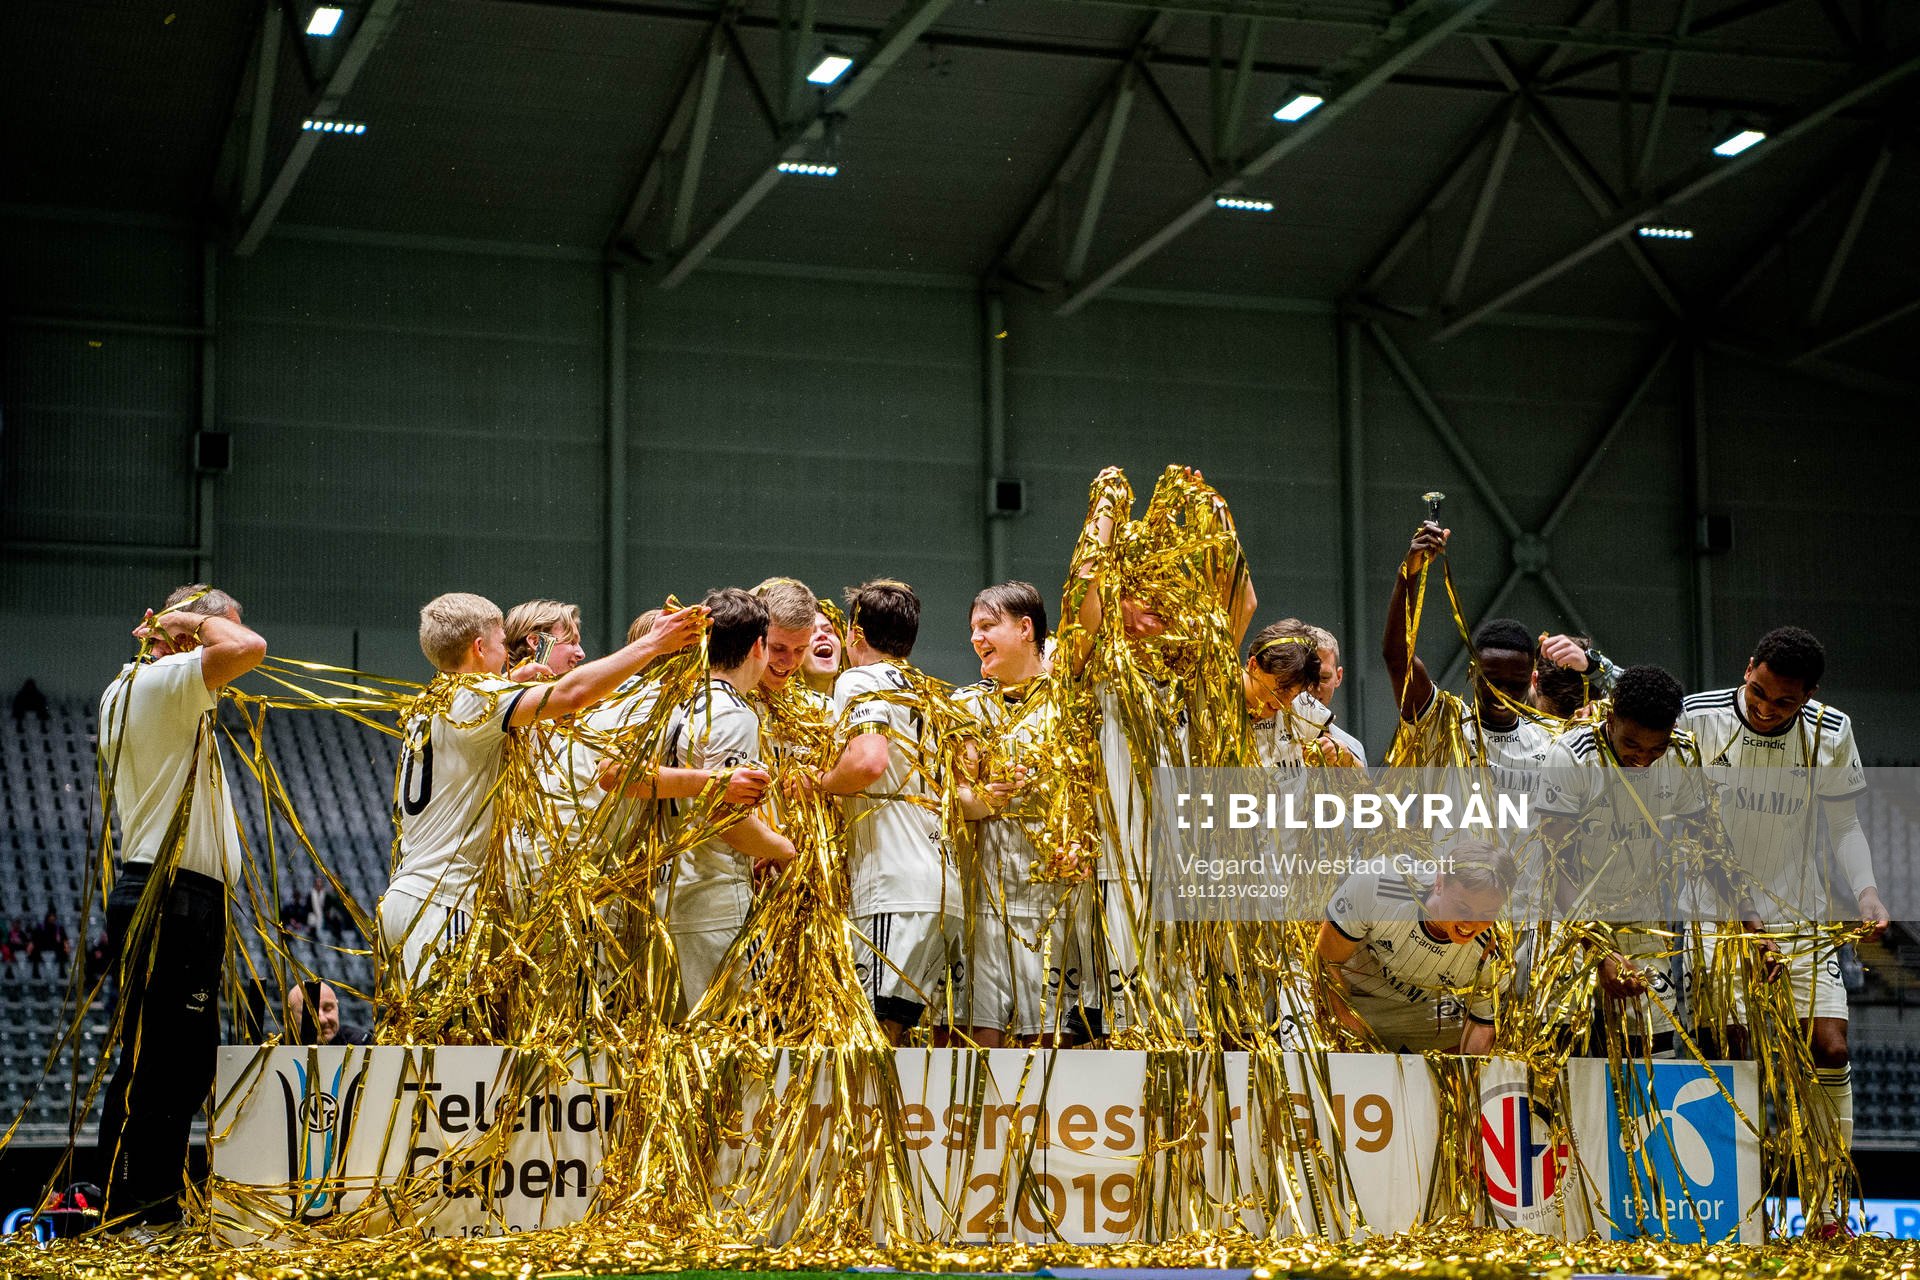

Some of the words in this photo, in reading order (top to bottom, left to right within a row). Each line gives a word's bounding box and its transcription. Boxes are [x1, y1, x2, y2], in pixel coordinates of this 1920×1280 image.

[1488, 734, 1521, 744] candic
[1743, 736, 1786, 750] Scandic
[1489, 764, 1542, 792] SALMA
[1409, 929, 1447, 957] Scandic
[404, 1081, 615, 1132] Telenor
[404, 1147, 588, 1212] Cupen
[967, 1173, 1142, 1234] 2019
[1622, 1194, 1724, 1221] telenor
